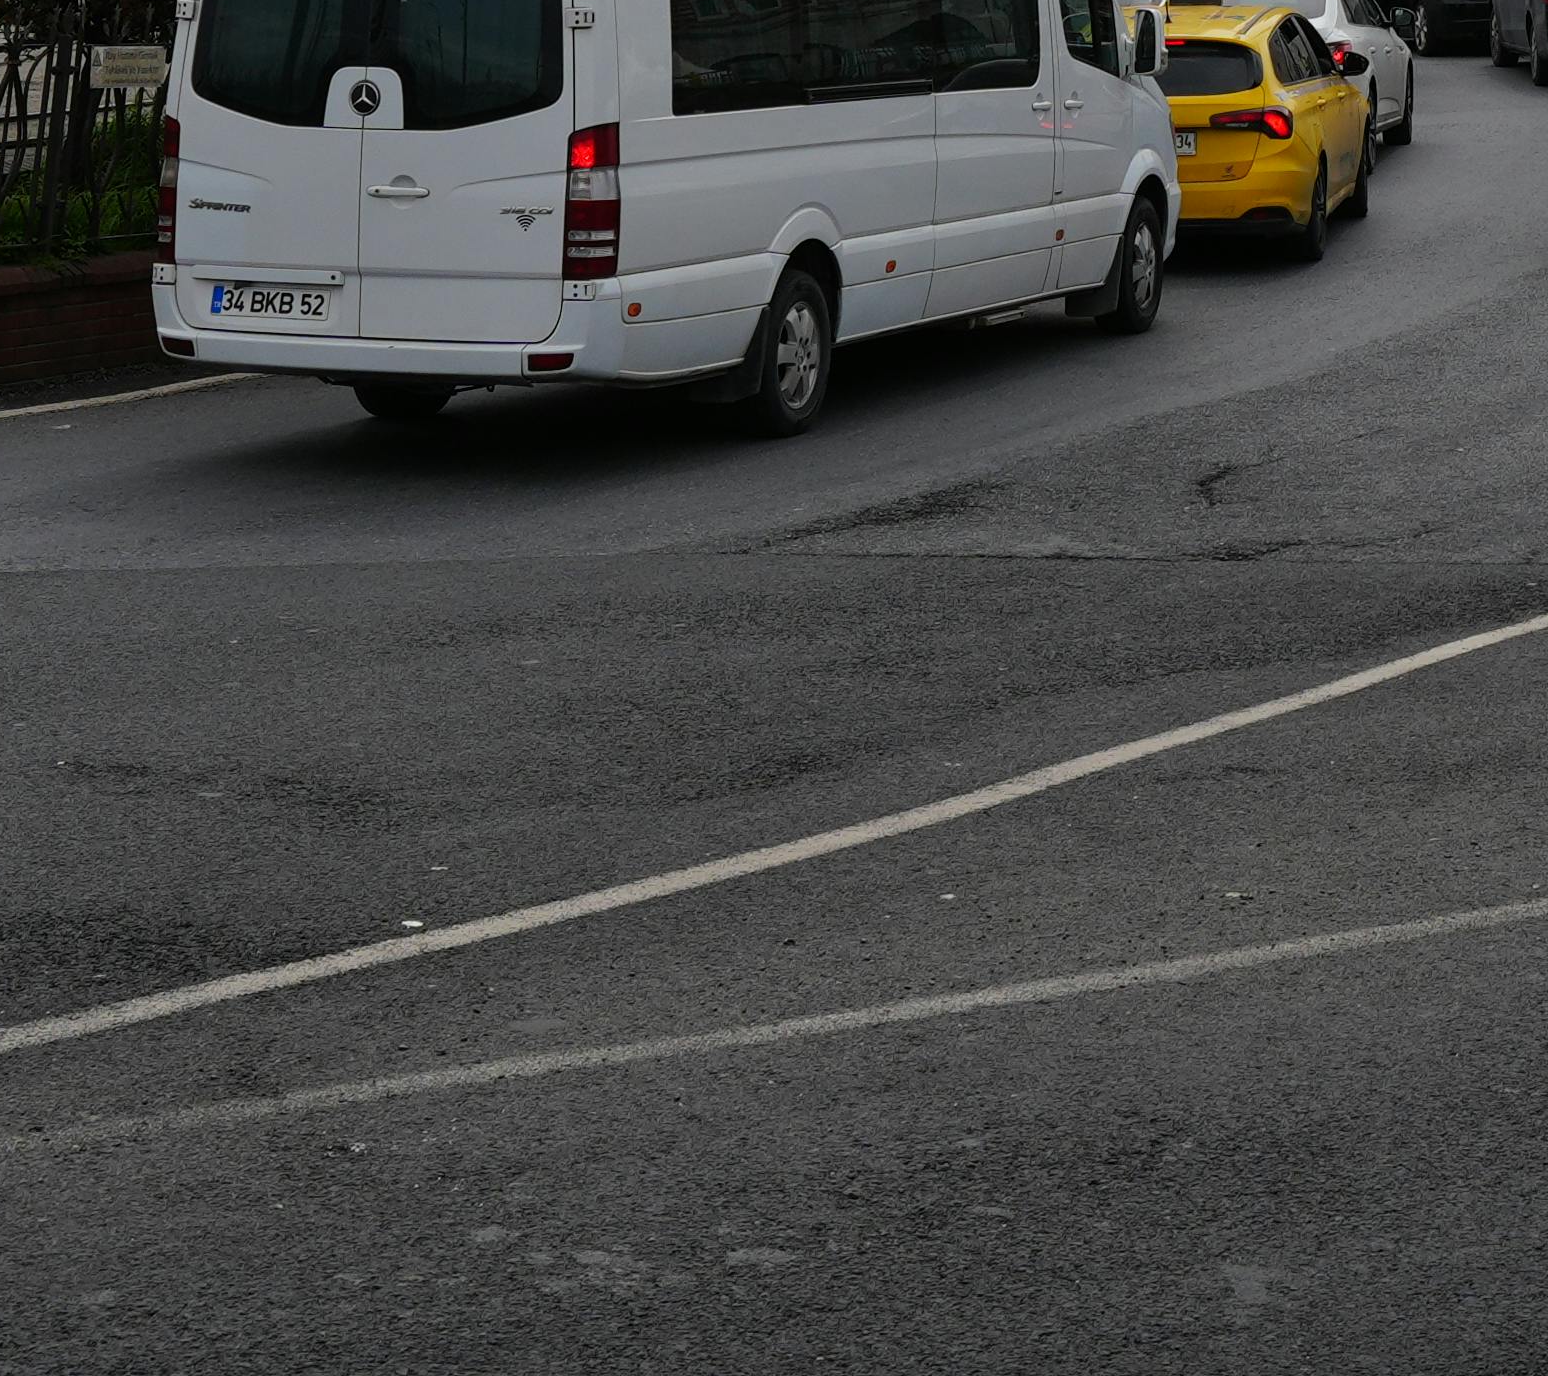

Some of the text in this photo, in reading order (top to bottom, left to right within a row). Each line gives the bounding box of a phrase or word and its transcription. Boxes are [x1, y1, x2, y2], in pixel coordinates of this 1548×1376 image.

[1176, 135, 1191, 148] 34
[188, 198, 251, 213] SPRINTER
[223, 289, 244, 311] 34
[250, 290, 294, 314] BKB
[300, 293, 325, 315] 52
